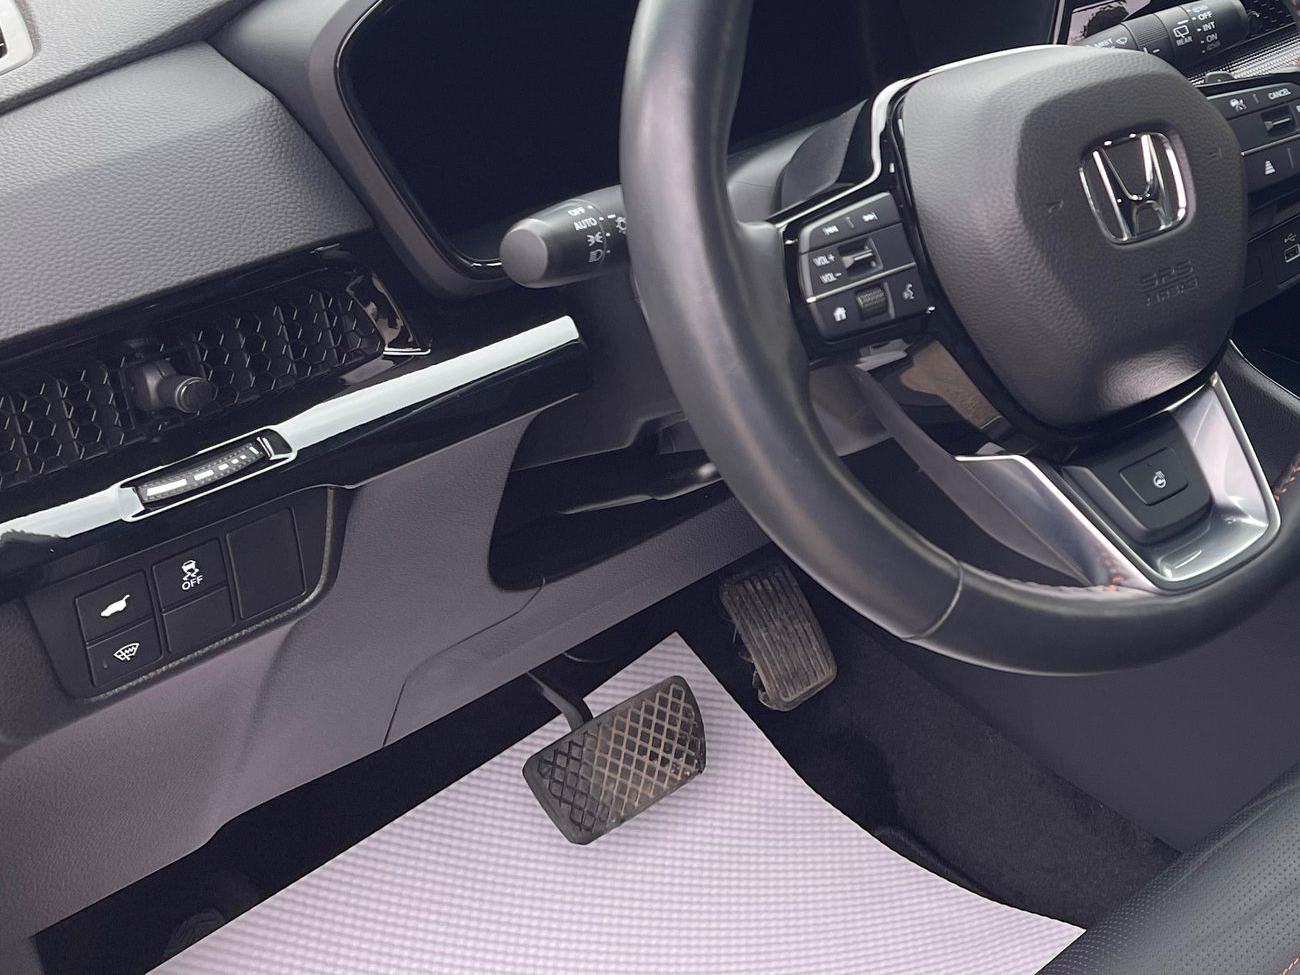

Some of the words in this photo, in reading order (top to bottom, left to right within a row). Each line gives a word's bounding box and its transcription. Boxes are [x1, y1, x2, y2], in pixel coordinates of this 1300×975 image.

[1198, 10, 1213, 21] OFF
[1202, 21, 1216, 32] INT
[1176, 35, 1193, 47] REAR
[1206, 32, 1218, 43] ON
[1268, 88, 1291, 100] CANCEL
[568, 206, 585, 216] OFF
[573, 217, 597, 230] AUTO
[181, 575, 203, 591] OFF
